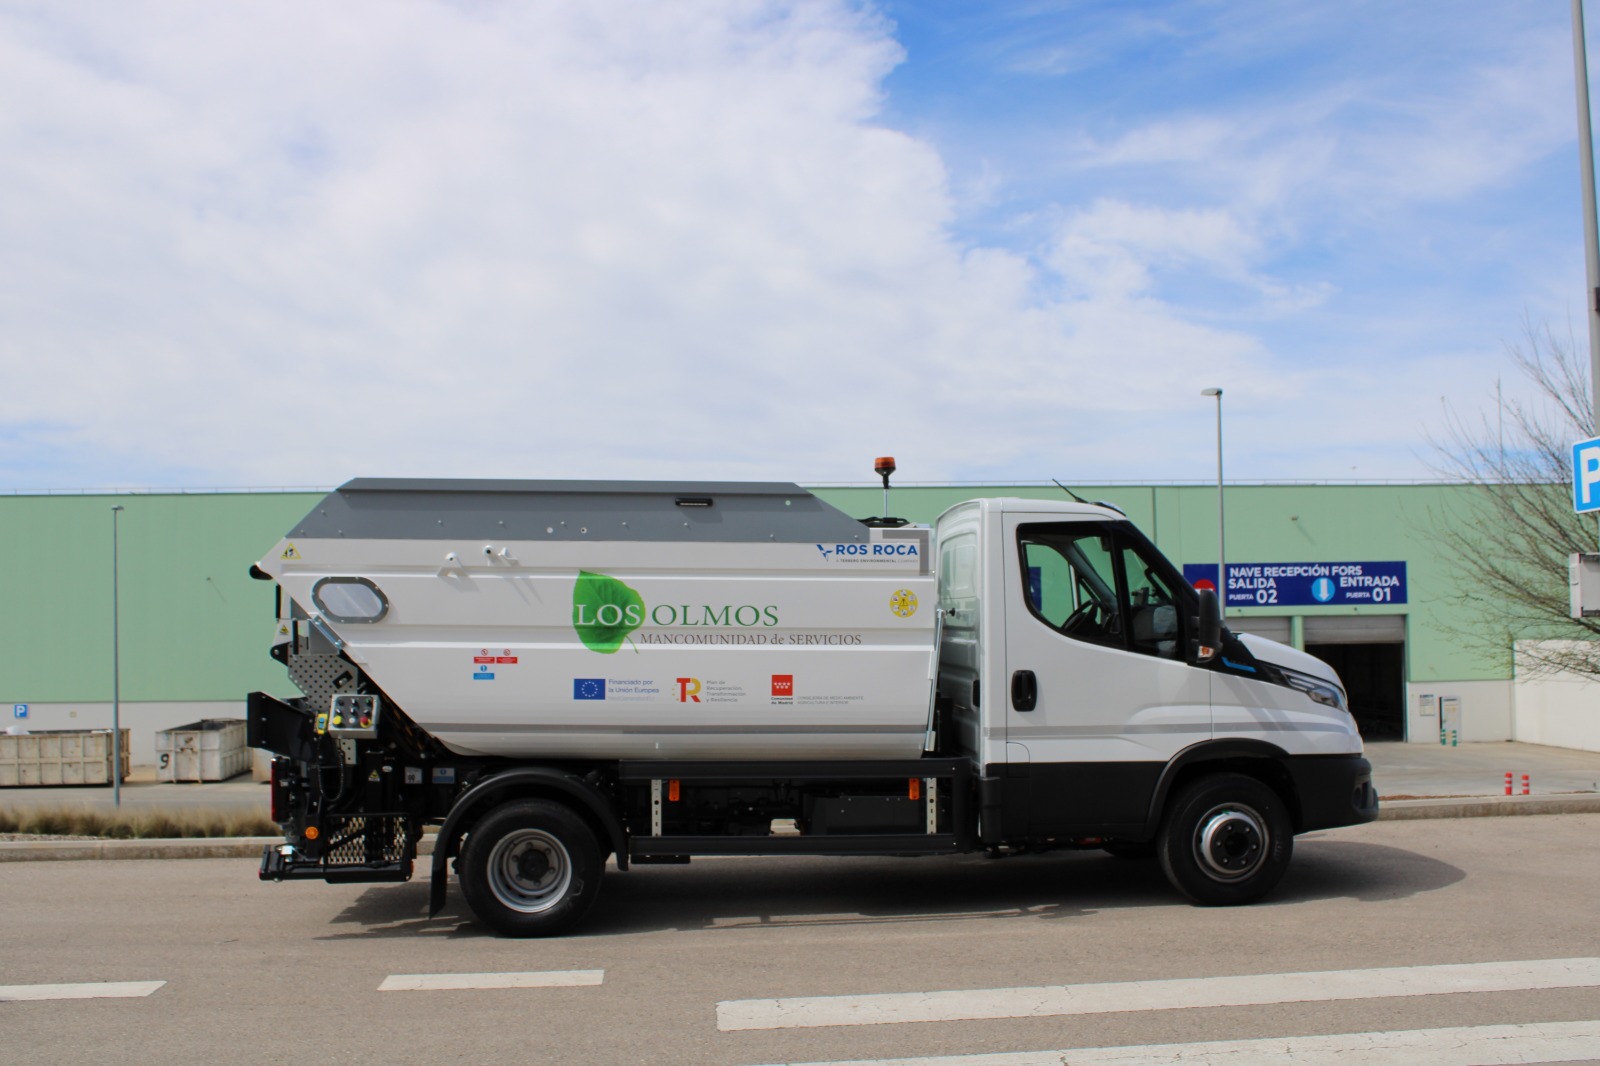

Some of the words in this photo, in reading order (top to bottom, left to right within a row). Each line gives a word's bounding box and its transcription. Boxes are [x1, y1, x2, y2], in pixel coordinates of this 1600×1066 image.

[1579, 445, 1600, 504] P
[836, 544, 868, 556] ROS
[873, 544, 918, 556] ROCA
[1230, 567, 1262, 578] NAVE
[1264, 564, 1330, 577] RECEPCIÓN
[1332, 566, 1362, 576] FORS
[1228, 578, 1276, 589] SALIDA
[1340, 576, 1400, 588] ENTRADA
[1256, 590, 1278, 604] 02
[1372, 588, 1392, 602] 01
[576, 604, 640, 626] LOS
[652, 604, 778, 626] OLMOS
[640, 633, 767, 645] MANCOMUNIDAD
[770, 633, 785, 645] de
[788, 634, 862, 646] SERVICIOS
[16, 705, 26, 717] P
[160, 753, 170, 770] 9
